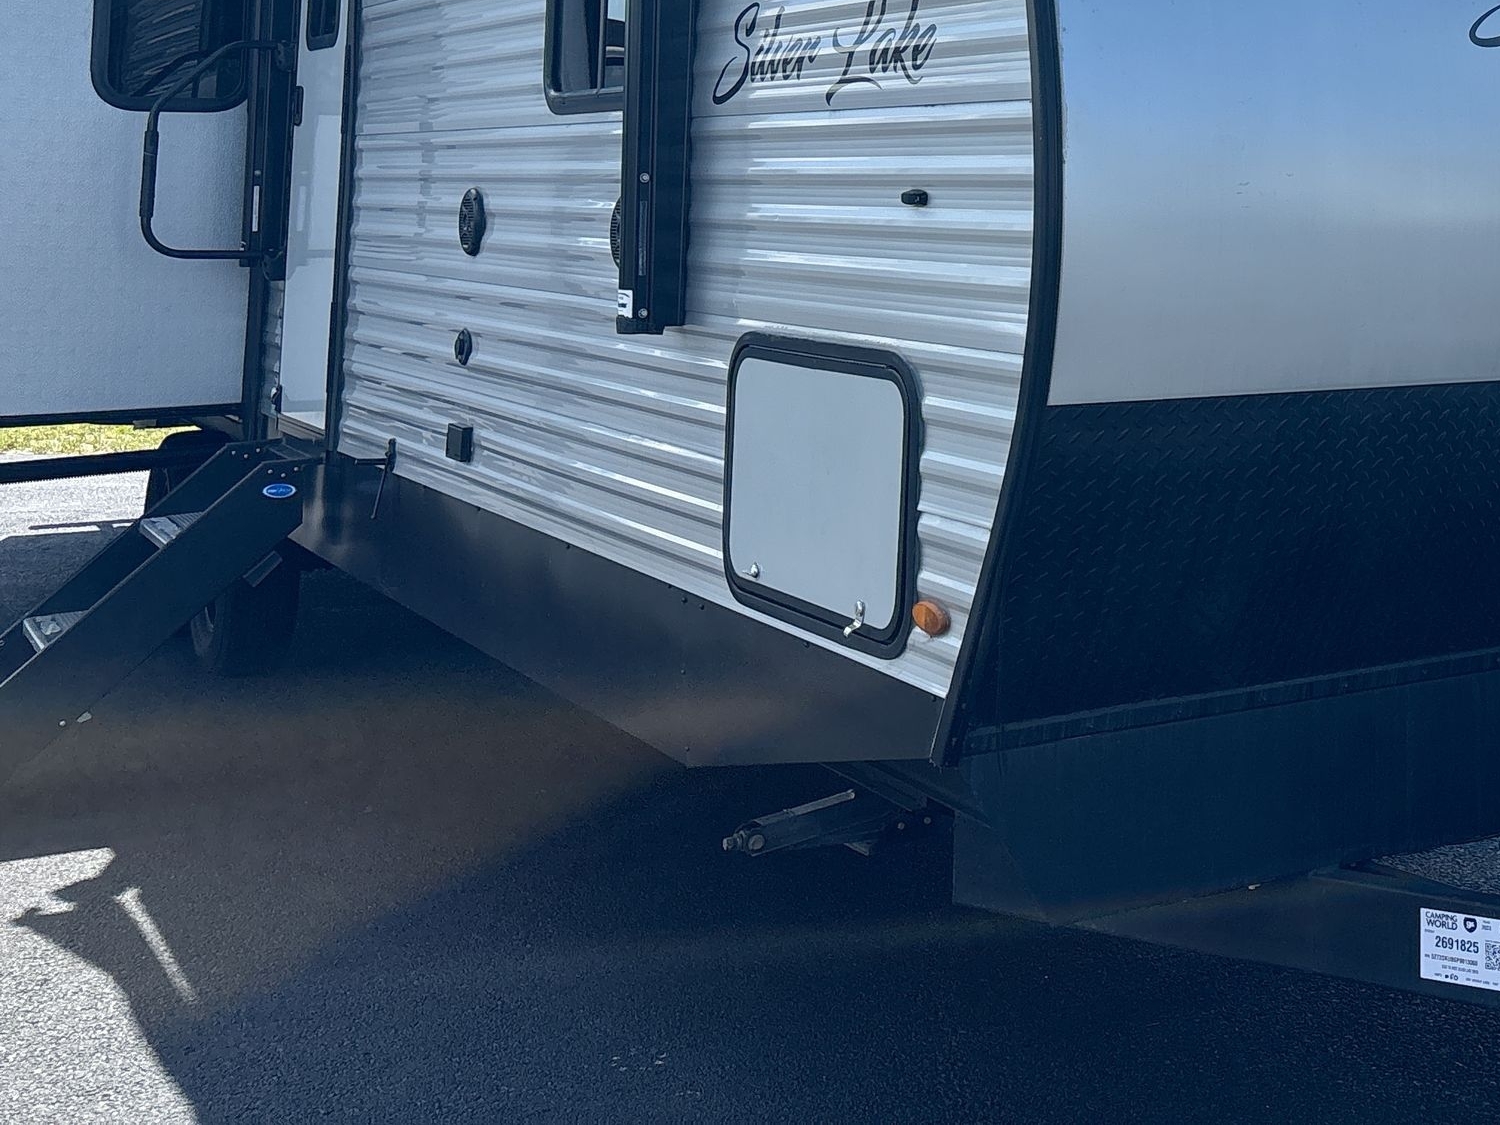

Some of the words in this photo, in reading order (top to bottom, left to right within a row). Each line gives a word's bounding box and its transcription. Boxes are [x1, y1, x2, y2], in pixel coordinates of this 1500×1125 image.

[712, 1, 822, 106] Silver
[1425, 911, 1458, 923] CAMPING
[1426, 918, 1459, 931] WORLD
[1434, 935, 1480, 954] 2691825
